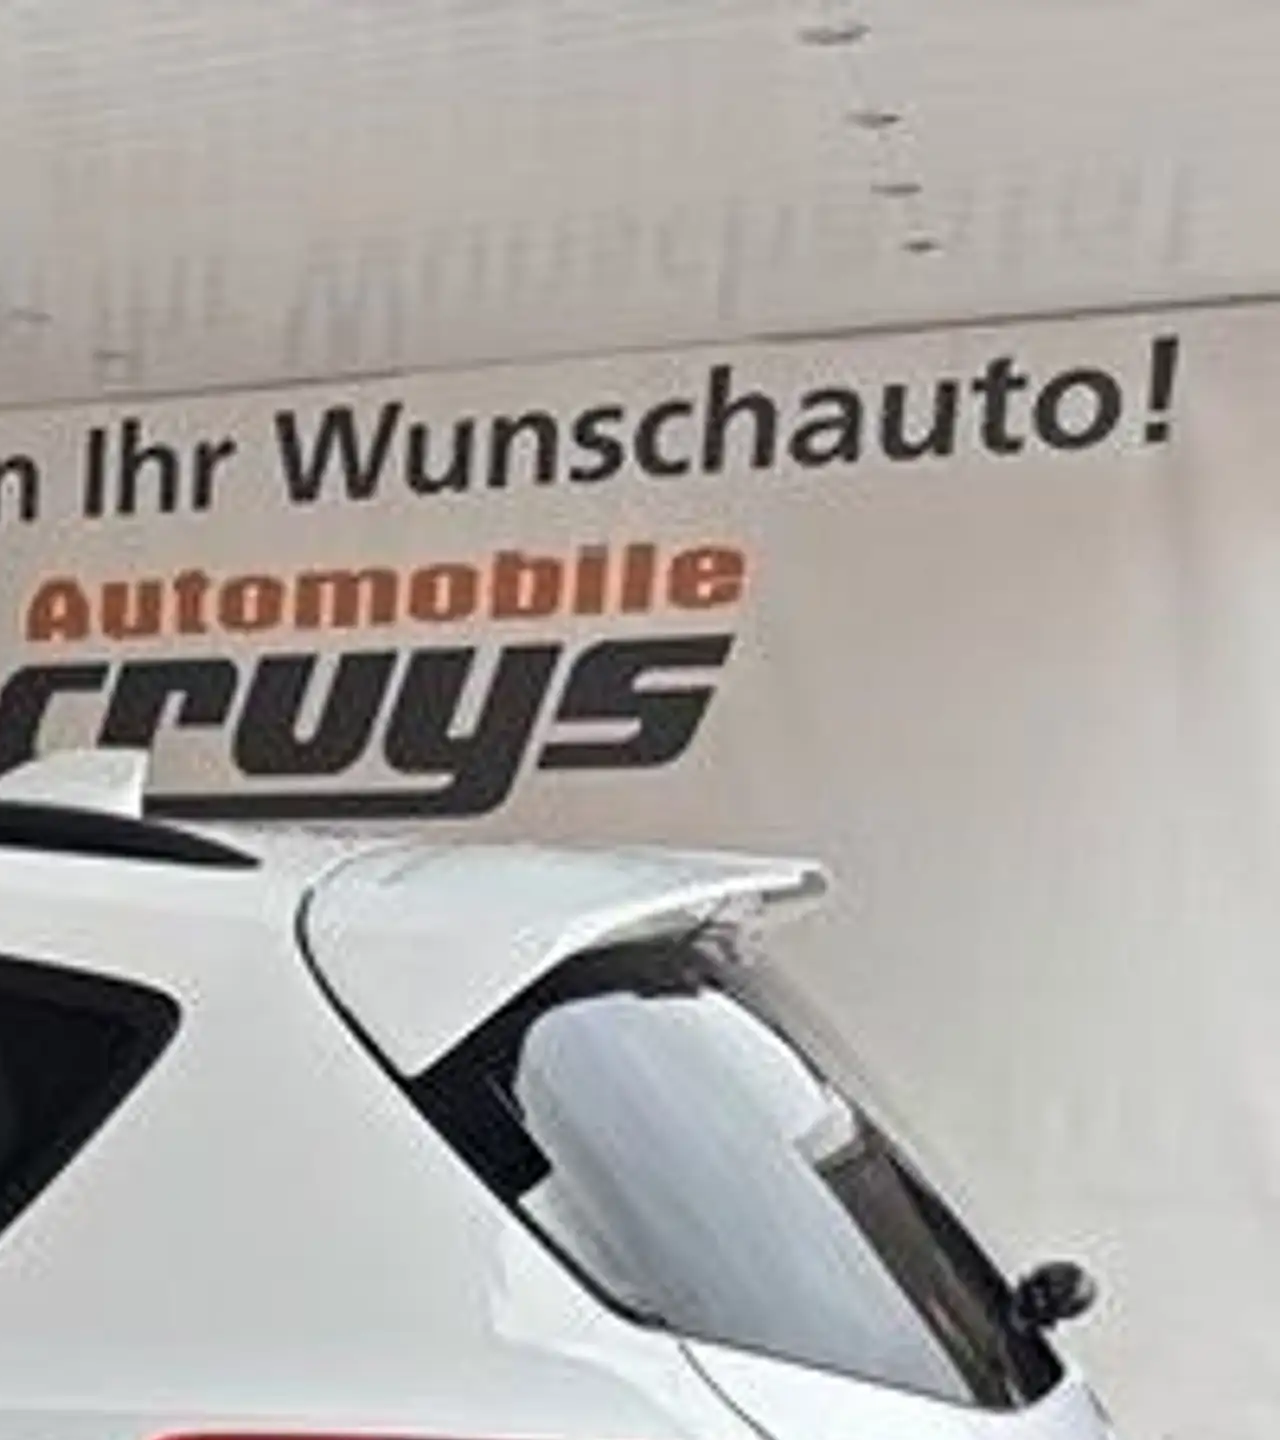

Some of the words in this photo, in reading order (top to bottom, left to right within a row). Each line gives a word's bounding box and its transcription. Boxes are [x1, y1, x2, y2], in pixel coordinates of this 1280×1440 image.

[83, 418, 238, 519] Ihr
[274, 335, 1180, 504] Wunschauto!
[26, 543, 746, 643] Automobile
